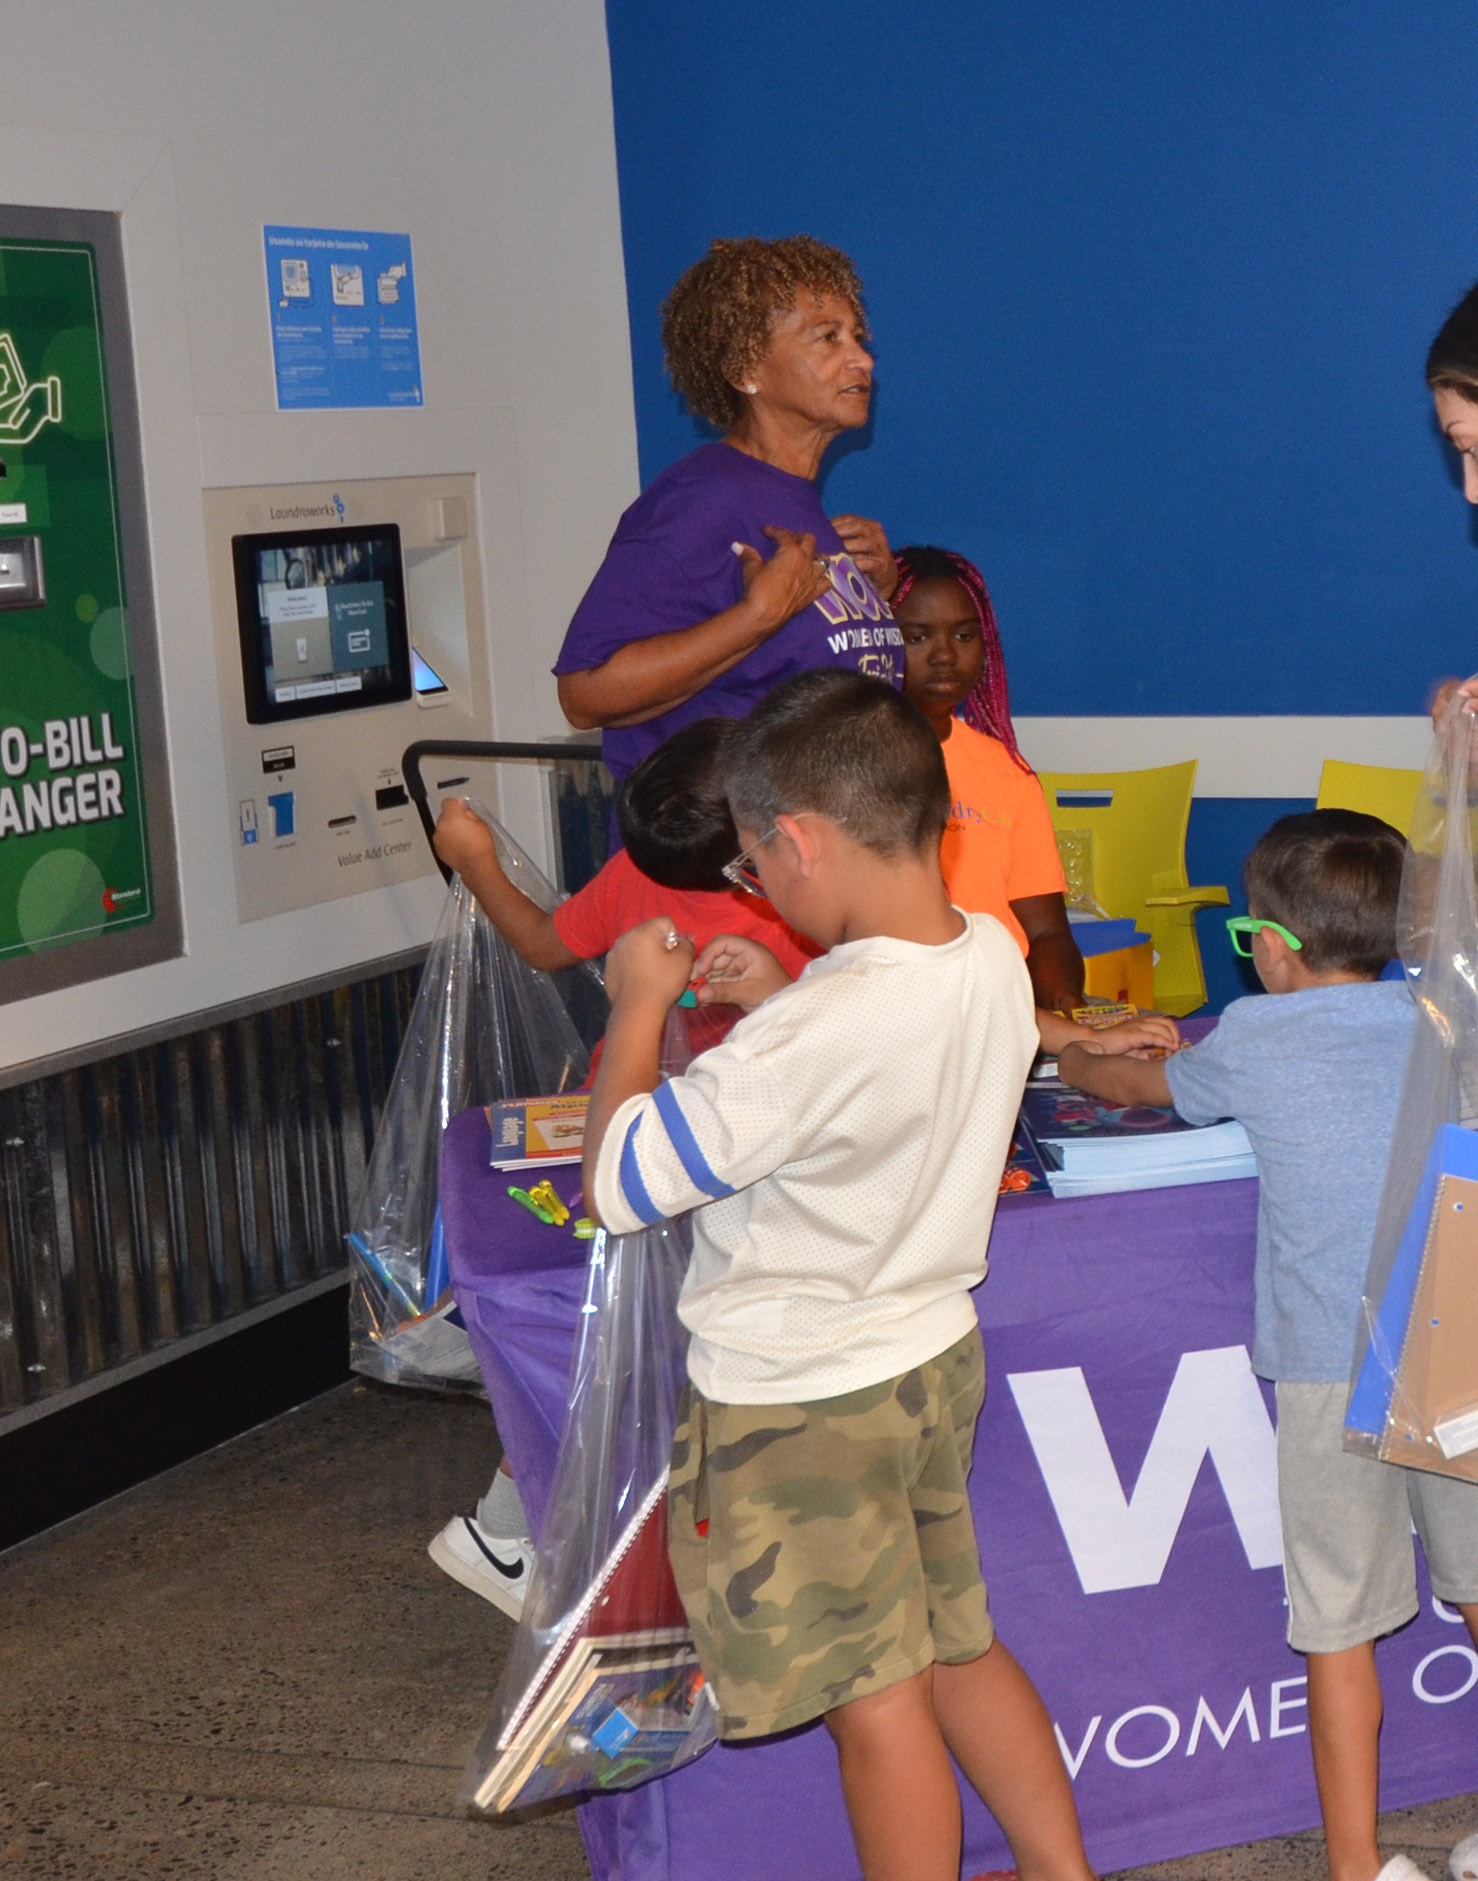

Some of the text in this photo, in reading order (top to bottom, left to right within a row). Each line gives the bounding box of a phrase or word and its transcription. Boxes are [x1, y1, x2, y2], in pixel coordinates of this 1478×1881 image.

[270, 503, 336, 520] Laundroworks
[337, 840, 413, 868] Value Add Center
[1053, 1675, 1308, 1782] WOME
